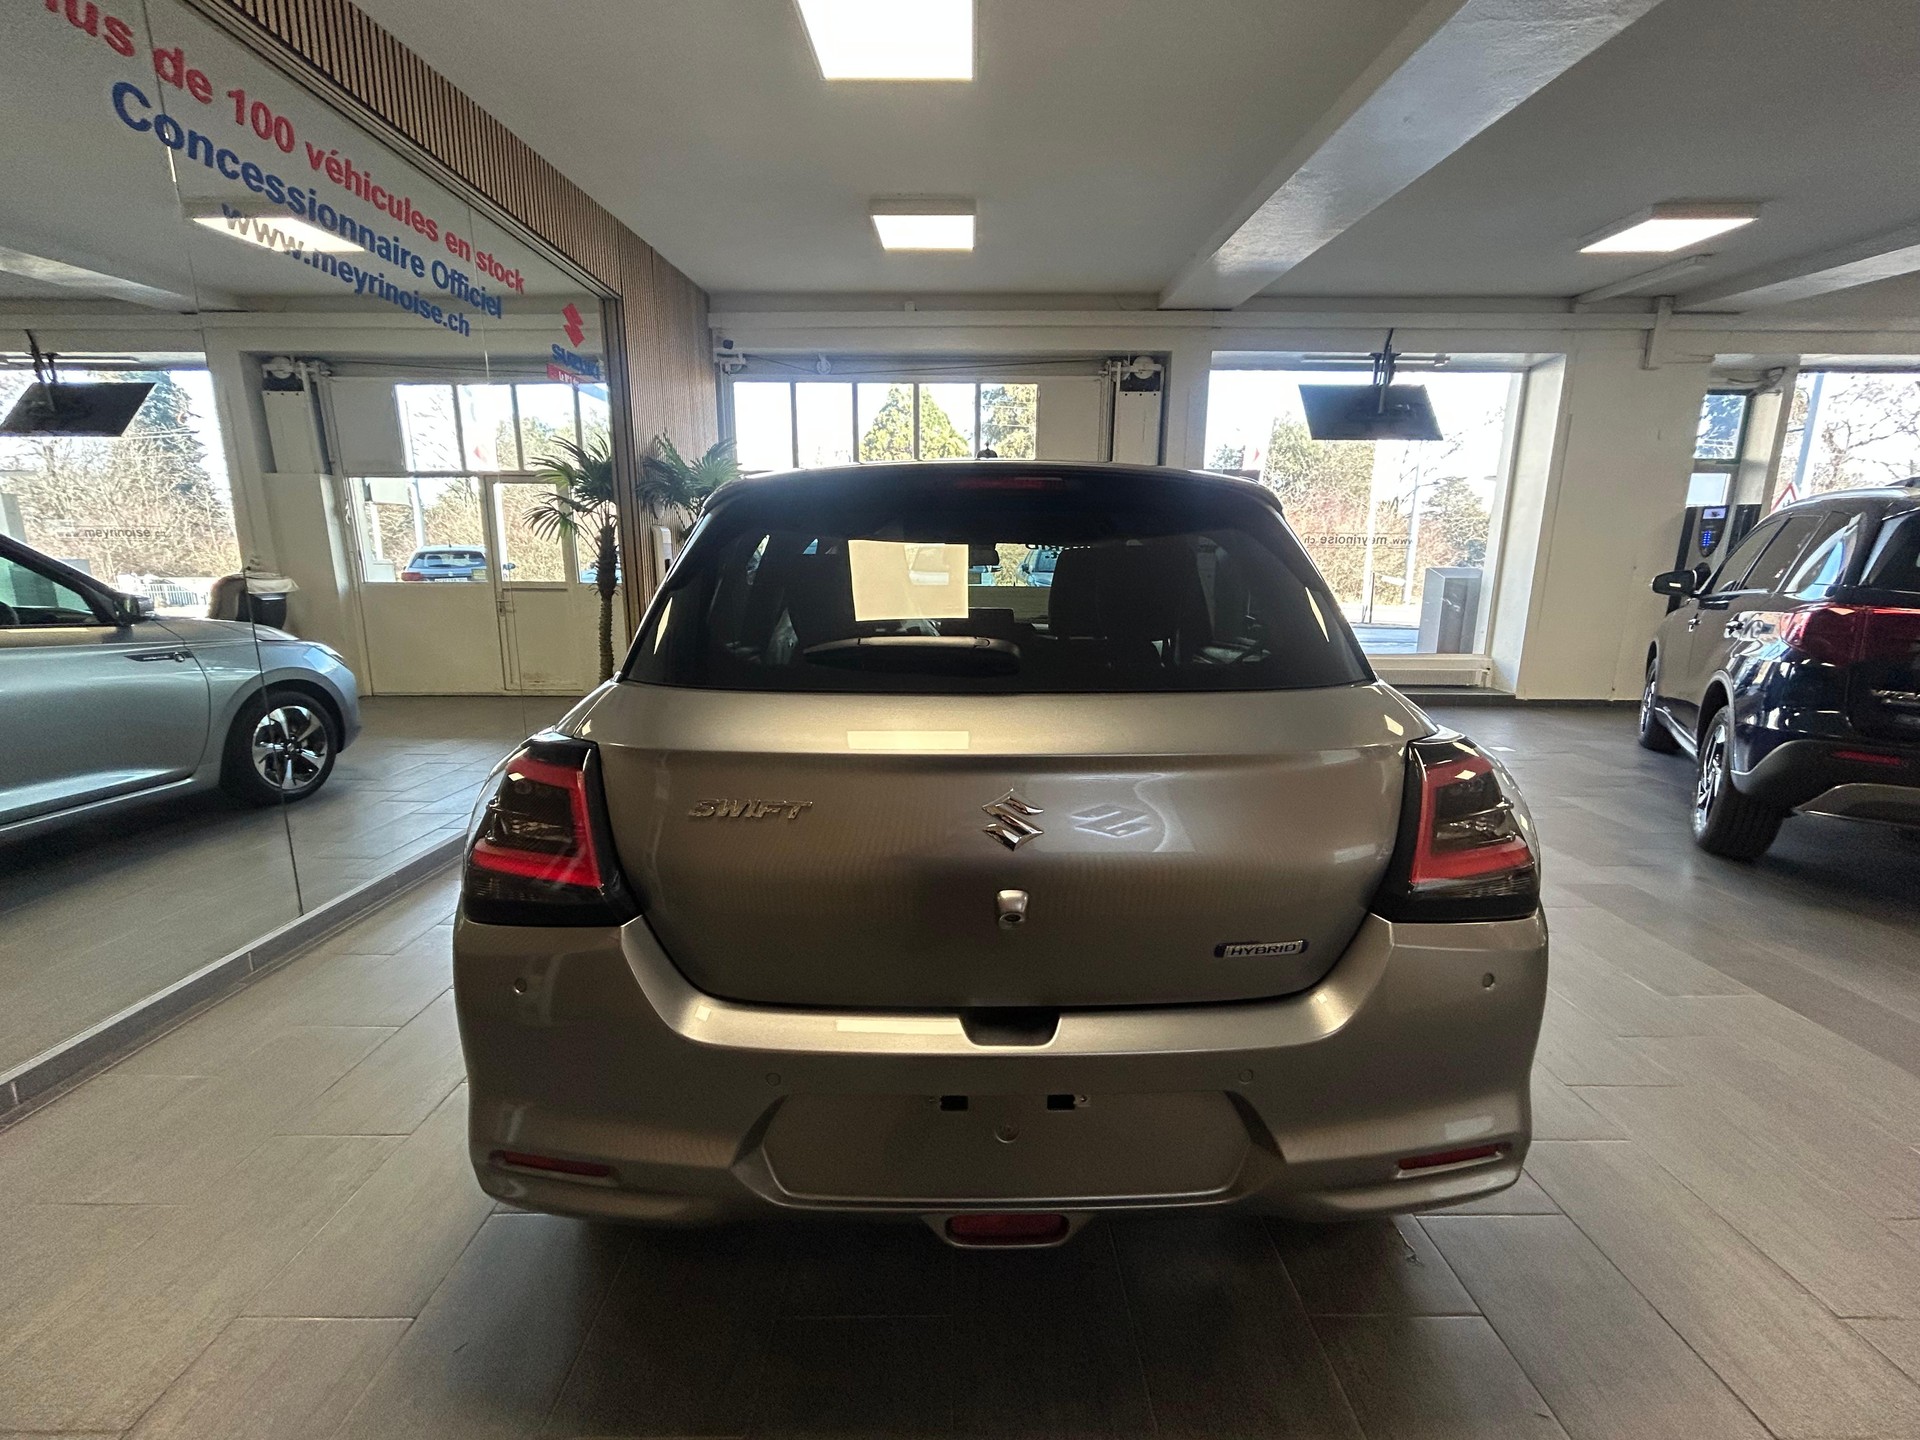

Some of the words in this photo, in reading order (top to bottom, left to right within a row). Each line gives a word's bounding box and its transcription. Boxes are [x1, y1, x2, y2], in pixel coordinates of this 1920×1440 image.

[112, 82, 425, 278] Concessionnaire
[431, 259, 502, 319] Officiel
[153, 47, 213, 104] de
[227, 87, 295, 154] 100
[306, 141, 439, 242] véhicules
[445, 231, 471, 262] en
[475, 250, 525, 295] stock
[221, 203, 471, 337] www.meyrinoise.ch
[688, 799, 813, 820] SWIFT
[1230, 943, 1297, 956] HYBRID
